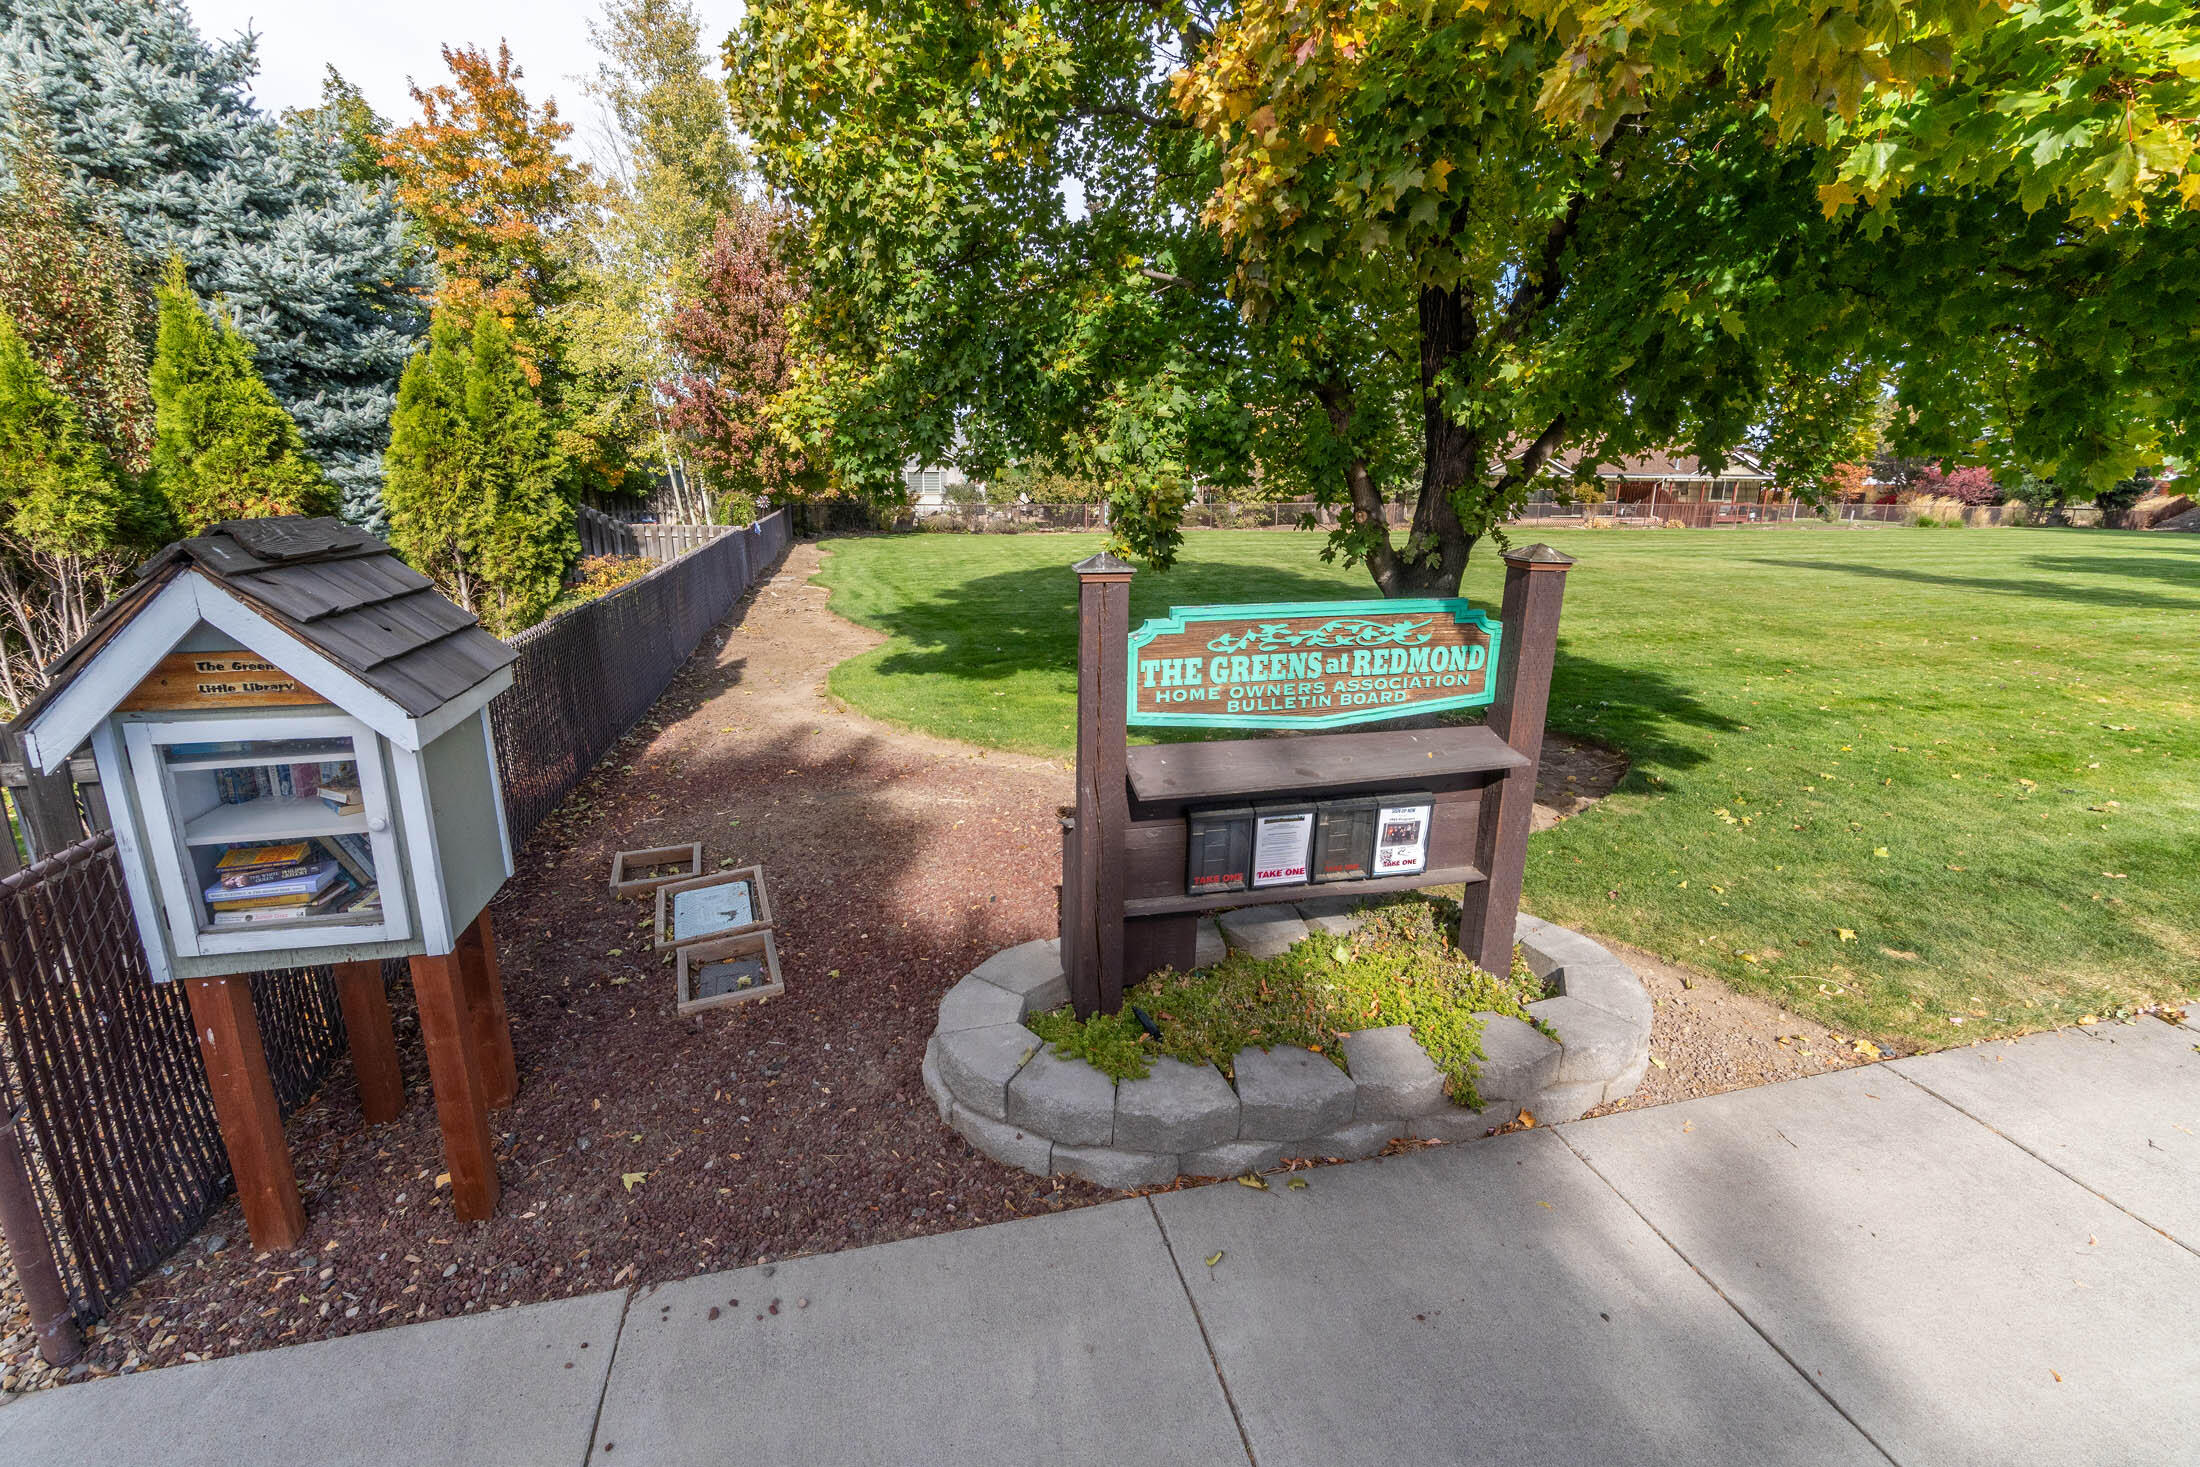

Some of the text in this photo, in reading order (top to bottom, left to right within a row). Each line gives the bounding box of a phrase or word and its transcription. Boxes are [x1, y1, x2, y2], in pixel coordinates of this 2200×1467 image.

[196, 662, 225, 671] The
[1140, 645, 1486, 688] THE GREENS at REDMOND
[199, 683, 294, 693] Little Library
[1156, 674, 1470, 703] HOME OWNERS ASSOCIATION
[1227, 691, 1407, 713] BULLETIN BOARD
[1383, 858, 1417, 868] TAKE ONE
[1194, 872, 1244, 885] TAKE ONE
[1257, 867, 1305, 879] TAKE ONE
